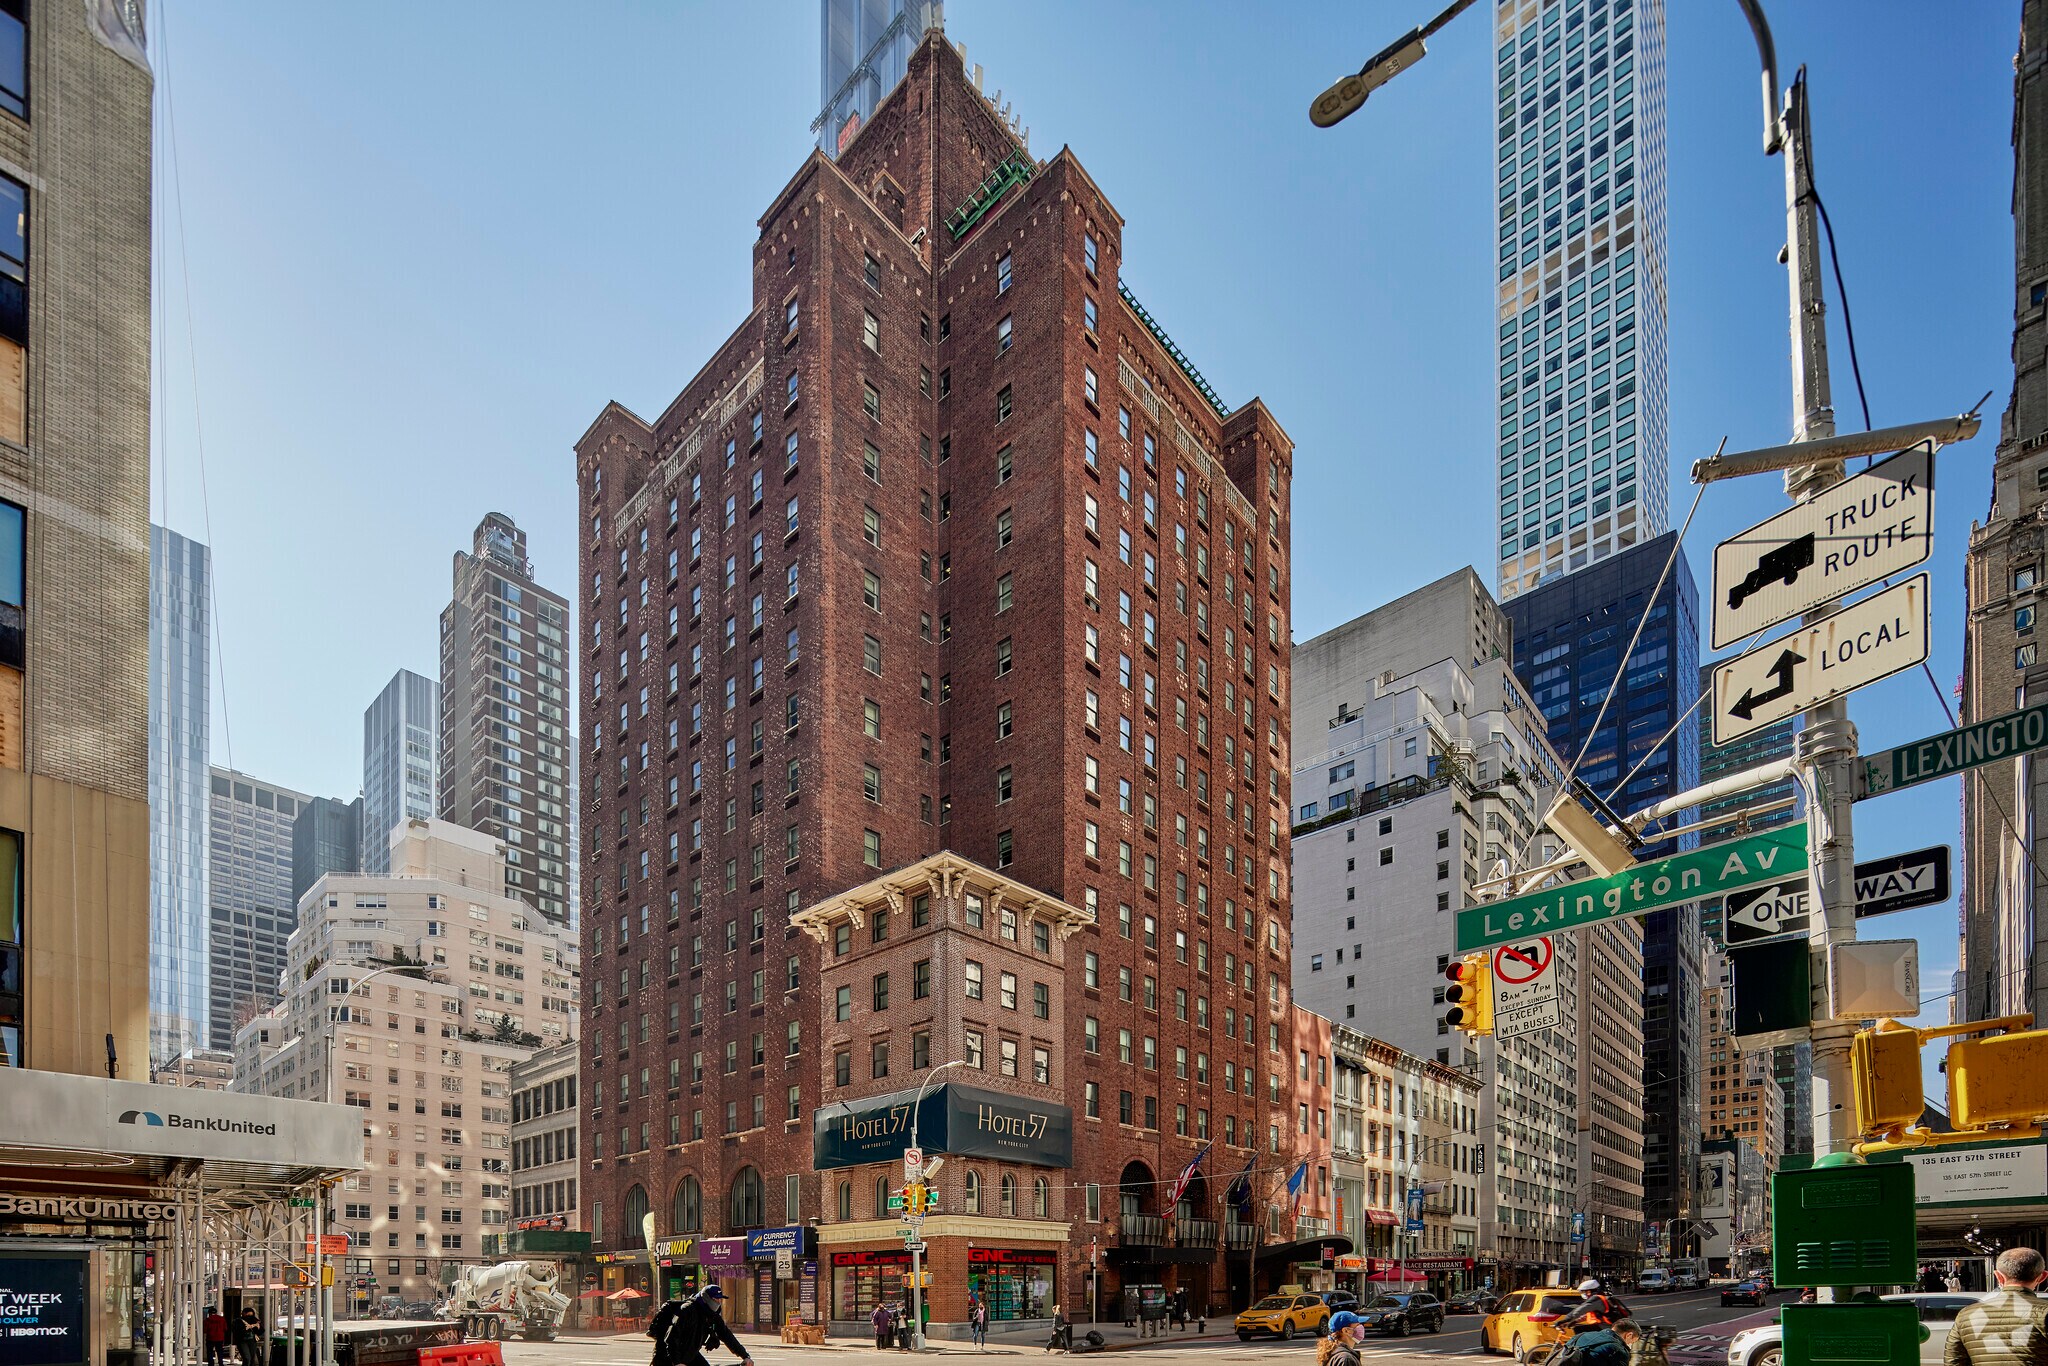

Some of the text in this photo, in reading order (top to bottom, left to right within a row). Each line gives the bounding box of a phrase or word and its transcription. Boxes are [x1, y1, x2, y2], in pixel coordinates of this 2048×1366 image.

[1825, 474, 1917, 536] TRUCK
[1825, 516, 1916, 577] ROUTE
[1760, 616, 1779, 626] DEPT
[1802, 577, 1869, 607] TRANSPORTATION
[1822, 617, 1910, 671] LOCAL
[1901, 710, 2048, 782] LEXINGTO
[1483, 847, 1779, 937] Lexington Av
[1753, 867, 1927, 923] ONE WAY
[1500, 993, 1552, 1012] EXCEPT SUNDAY
[1509, 1005, 1544, 1021] EXCEPT
[1502, 1015, 1554, 1036] MTA BUSES
[168, 1114, 276, 1136] BankUnited
[844, 1105, 910, 1141] HOTEL 57
[978, 1104, 1048, 1139] HOTEL 57
[1940, 1156, 1961, 1164] EAST
[1965, 1154, 1985, 1162] 57th
[1988, 1151, 2021, 1160] STREET
[296, 1199, 305, 1207] 57
[763, 1231, 797, 1239] CURRENCY
[763, 1239, 796, 1247] EXCHANGE
[654, 1239, 693, 1257] SUBWAY
[968, 1249, 1013, 1263] GNC
[778, 1260, 790, 1269] 25
[834, 1252, 875, 1266] GNC
[1422, 1261, 1463, 1269] RESTAURANT
[11, 1293, 62, 1304] WEEK
[365, 1336, 389, 1348] 20
